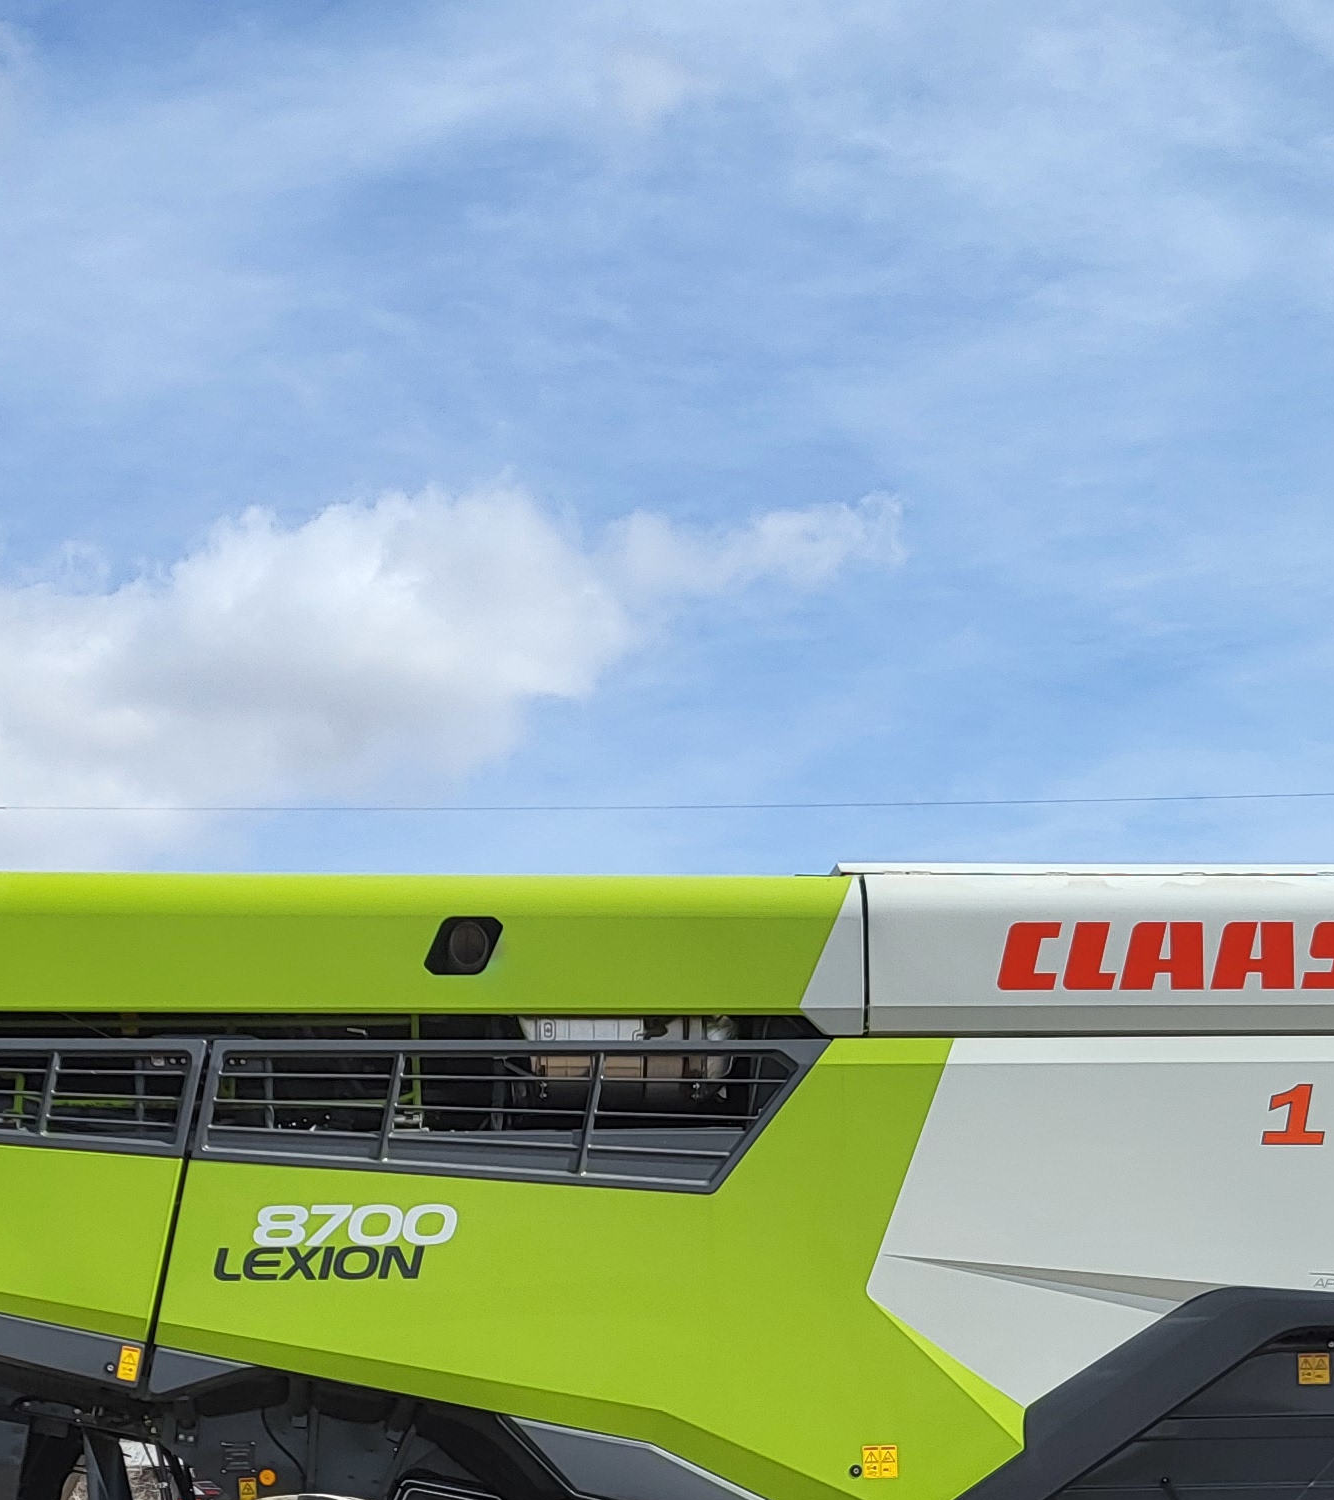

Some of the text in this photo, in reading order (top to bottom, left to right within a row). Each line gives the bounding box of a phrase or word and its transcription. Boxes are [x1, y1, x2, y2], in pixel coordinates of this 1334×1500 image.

[1260, 1083, 1325, 1146] 1
[253, 1203, 458, 1246] 8700
[213, 1246, 426, 1281] LEXION
